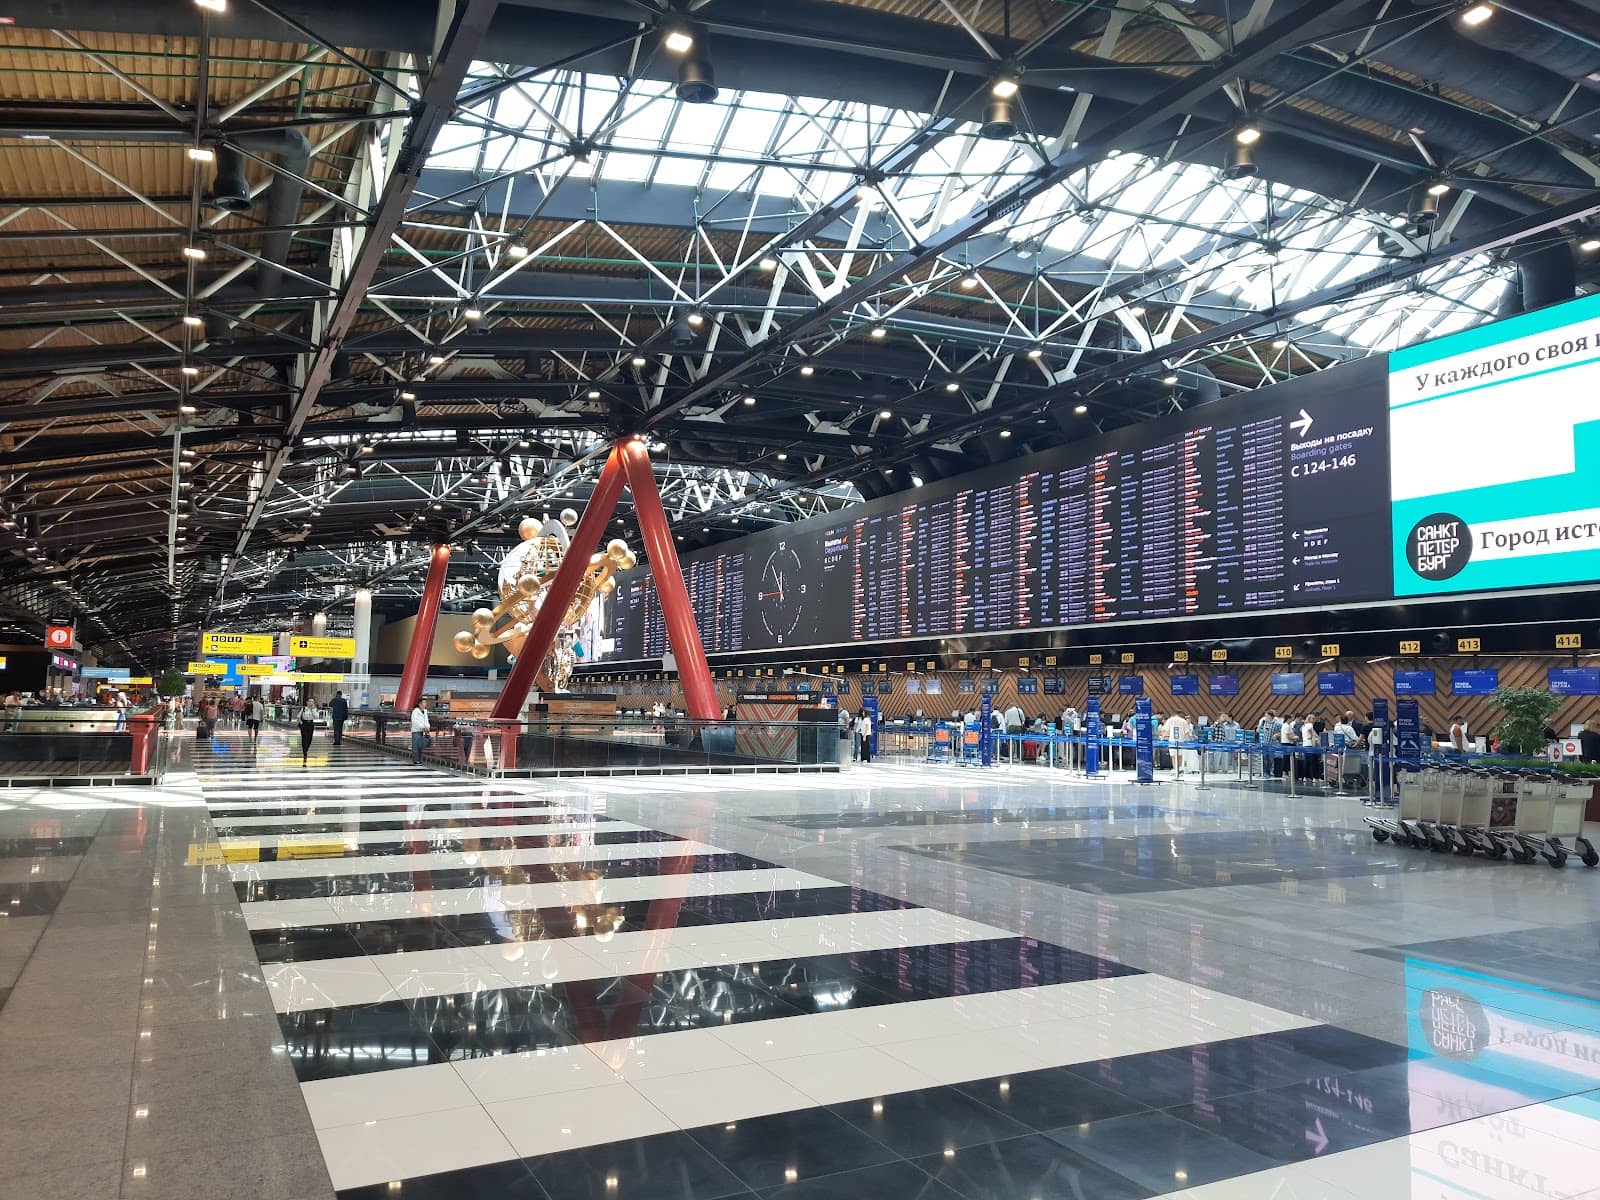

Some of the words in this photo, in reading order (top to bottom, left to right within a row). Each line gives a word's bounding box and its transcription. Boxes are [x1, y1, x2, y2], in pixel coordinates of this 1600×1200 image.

[1416, 373, 1429, 391] У
[1434, 351, 1530, 387] каждого
[1535, 336, 1588, 361] своя
[1290, 438, 1322, 451] Выходы
[1324, 435, 1335, 444] на
[1336, 426, 1374, 441] посадку
[1291, 447, 1327, 461] Boarding
[1329, 442, 1353, 455] gates
[1303, 454, 1357, 475] 124-146
[1417, 521, 1459, 542] САНКТ
[1481, 528, 1549, 551] Город
[1556, 522, 1600, 541] ист
[779, 541, 786, 550] 12
[1417, 537, 1460, 557] ПЕТЕР
[1418, 553, 1452, 572] БУРГ
[800, 584, 806, 593] 3
[1459, 640, 1479, 650] 413
[1557, 635, 1580, 646] 414
[1322, 645, 1338, 655] 411
[1400, 642, 1419, 652] 412
[1122, 653, 1134, 662] 407
[1212, 650, 1226, 659] 409
[1276, 648, 1291, 658] 410
